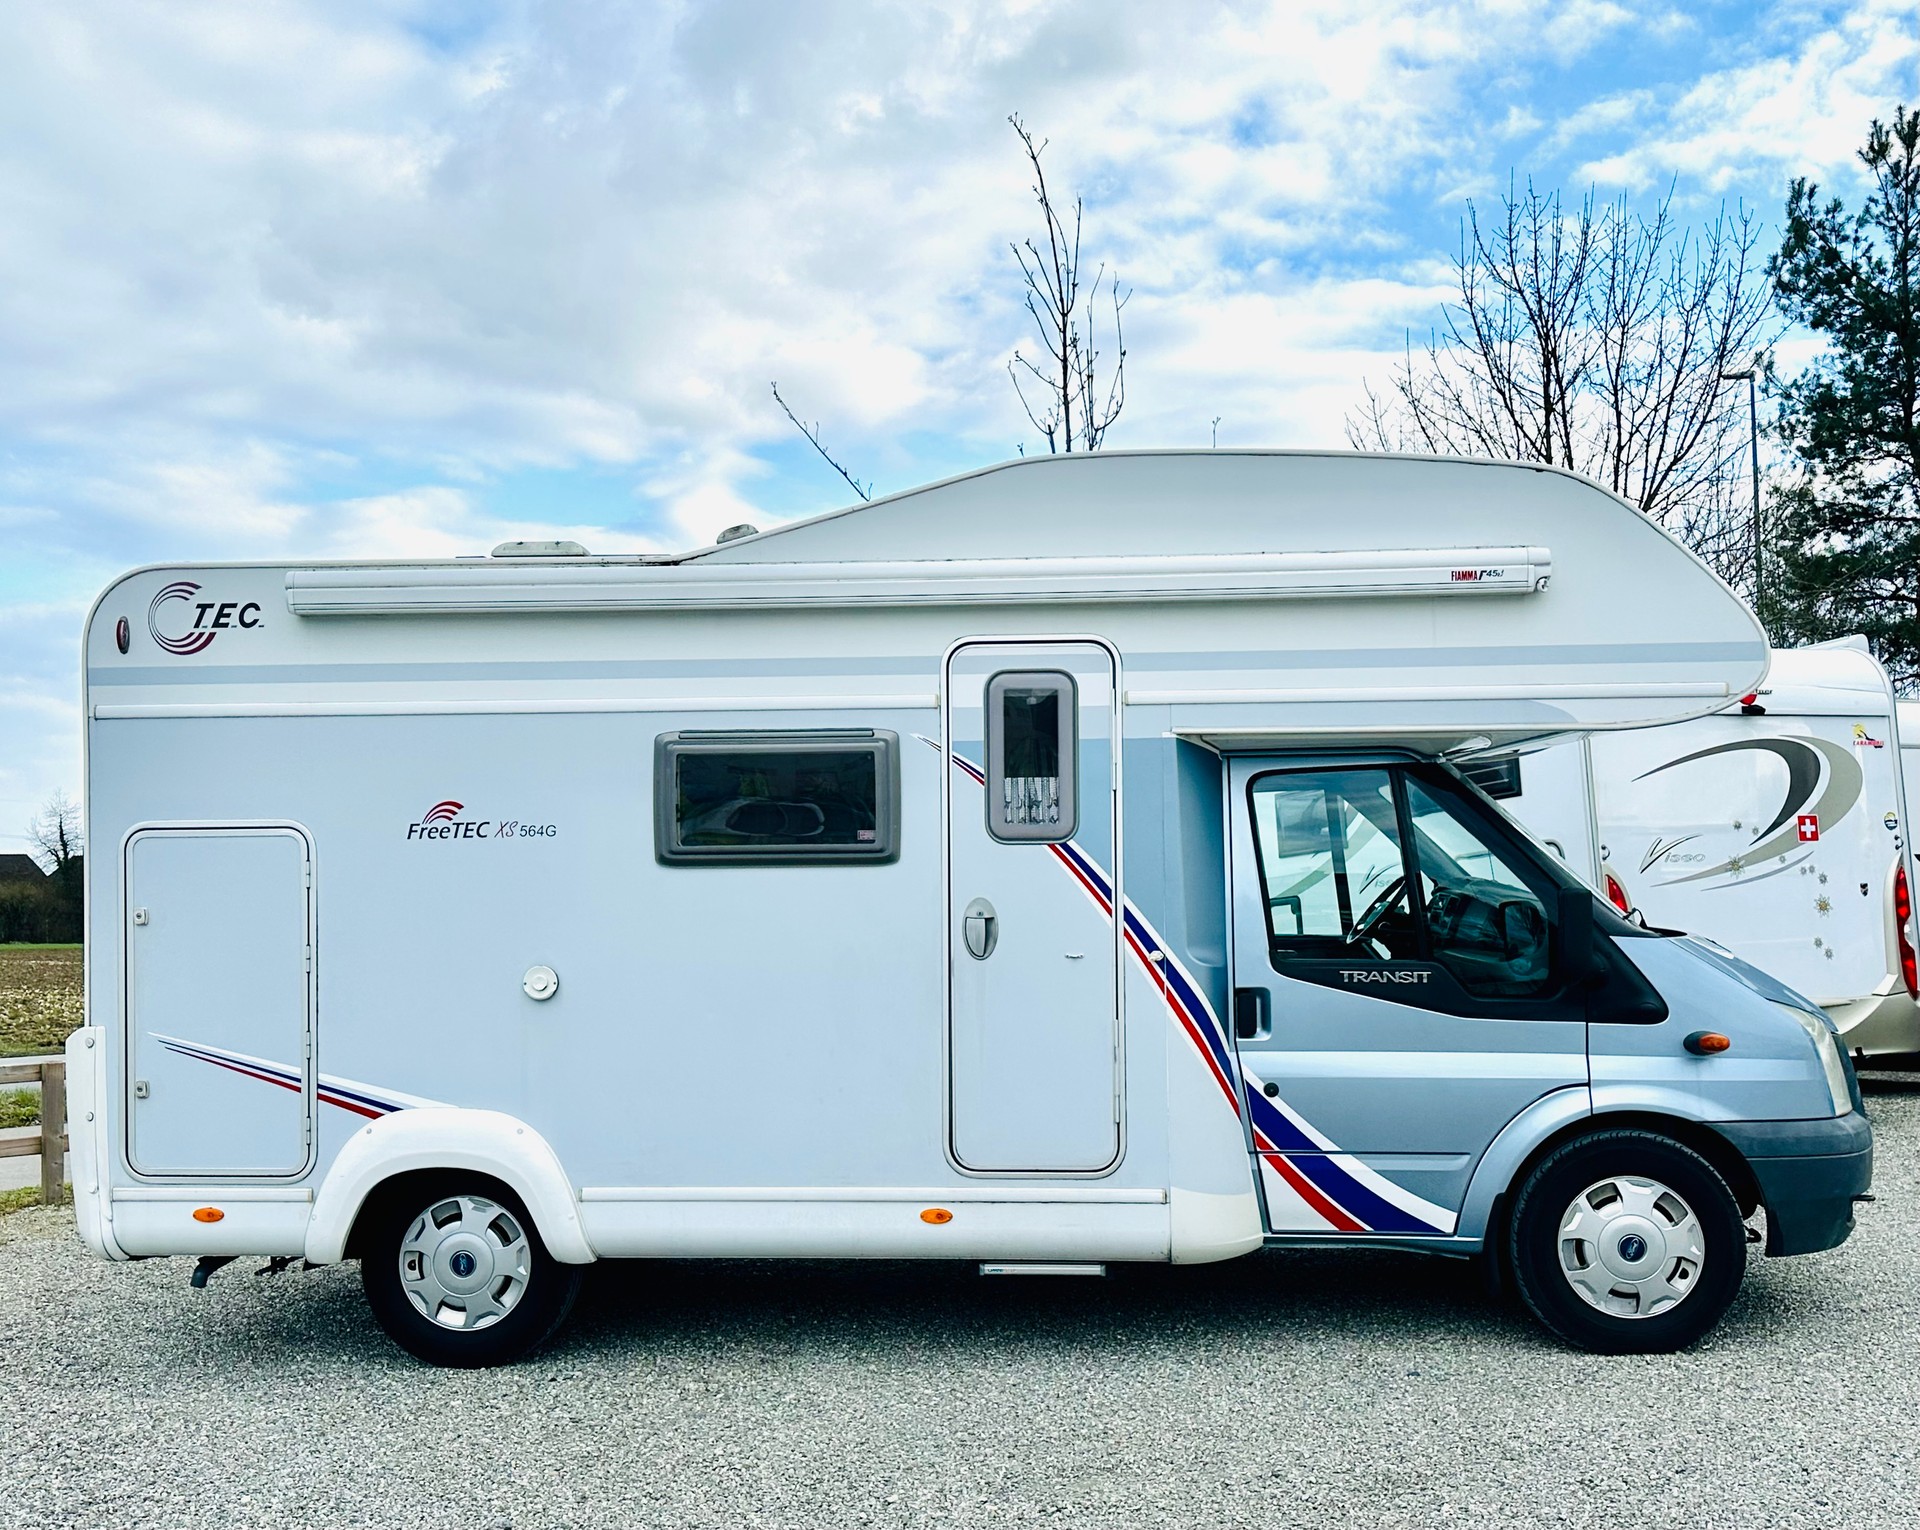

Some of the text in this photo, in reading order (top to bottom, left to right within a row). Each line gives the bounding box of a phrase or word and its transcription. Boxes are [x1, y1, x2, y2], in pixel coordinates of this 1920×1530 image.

[1451, 570, 1478, 581] FIAMMA
[407, 820, 557, 840] FreeTEC XS 564G
[1339, 970, 1432, 984] TRANSIT
